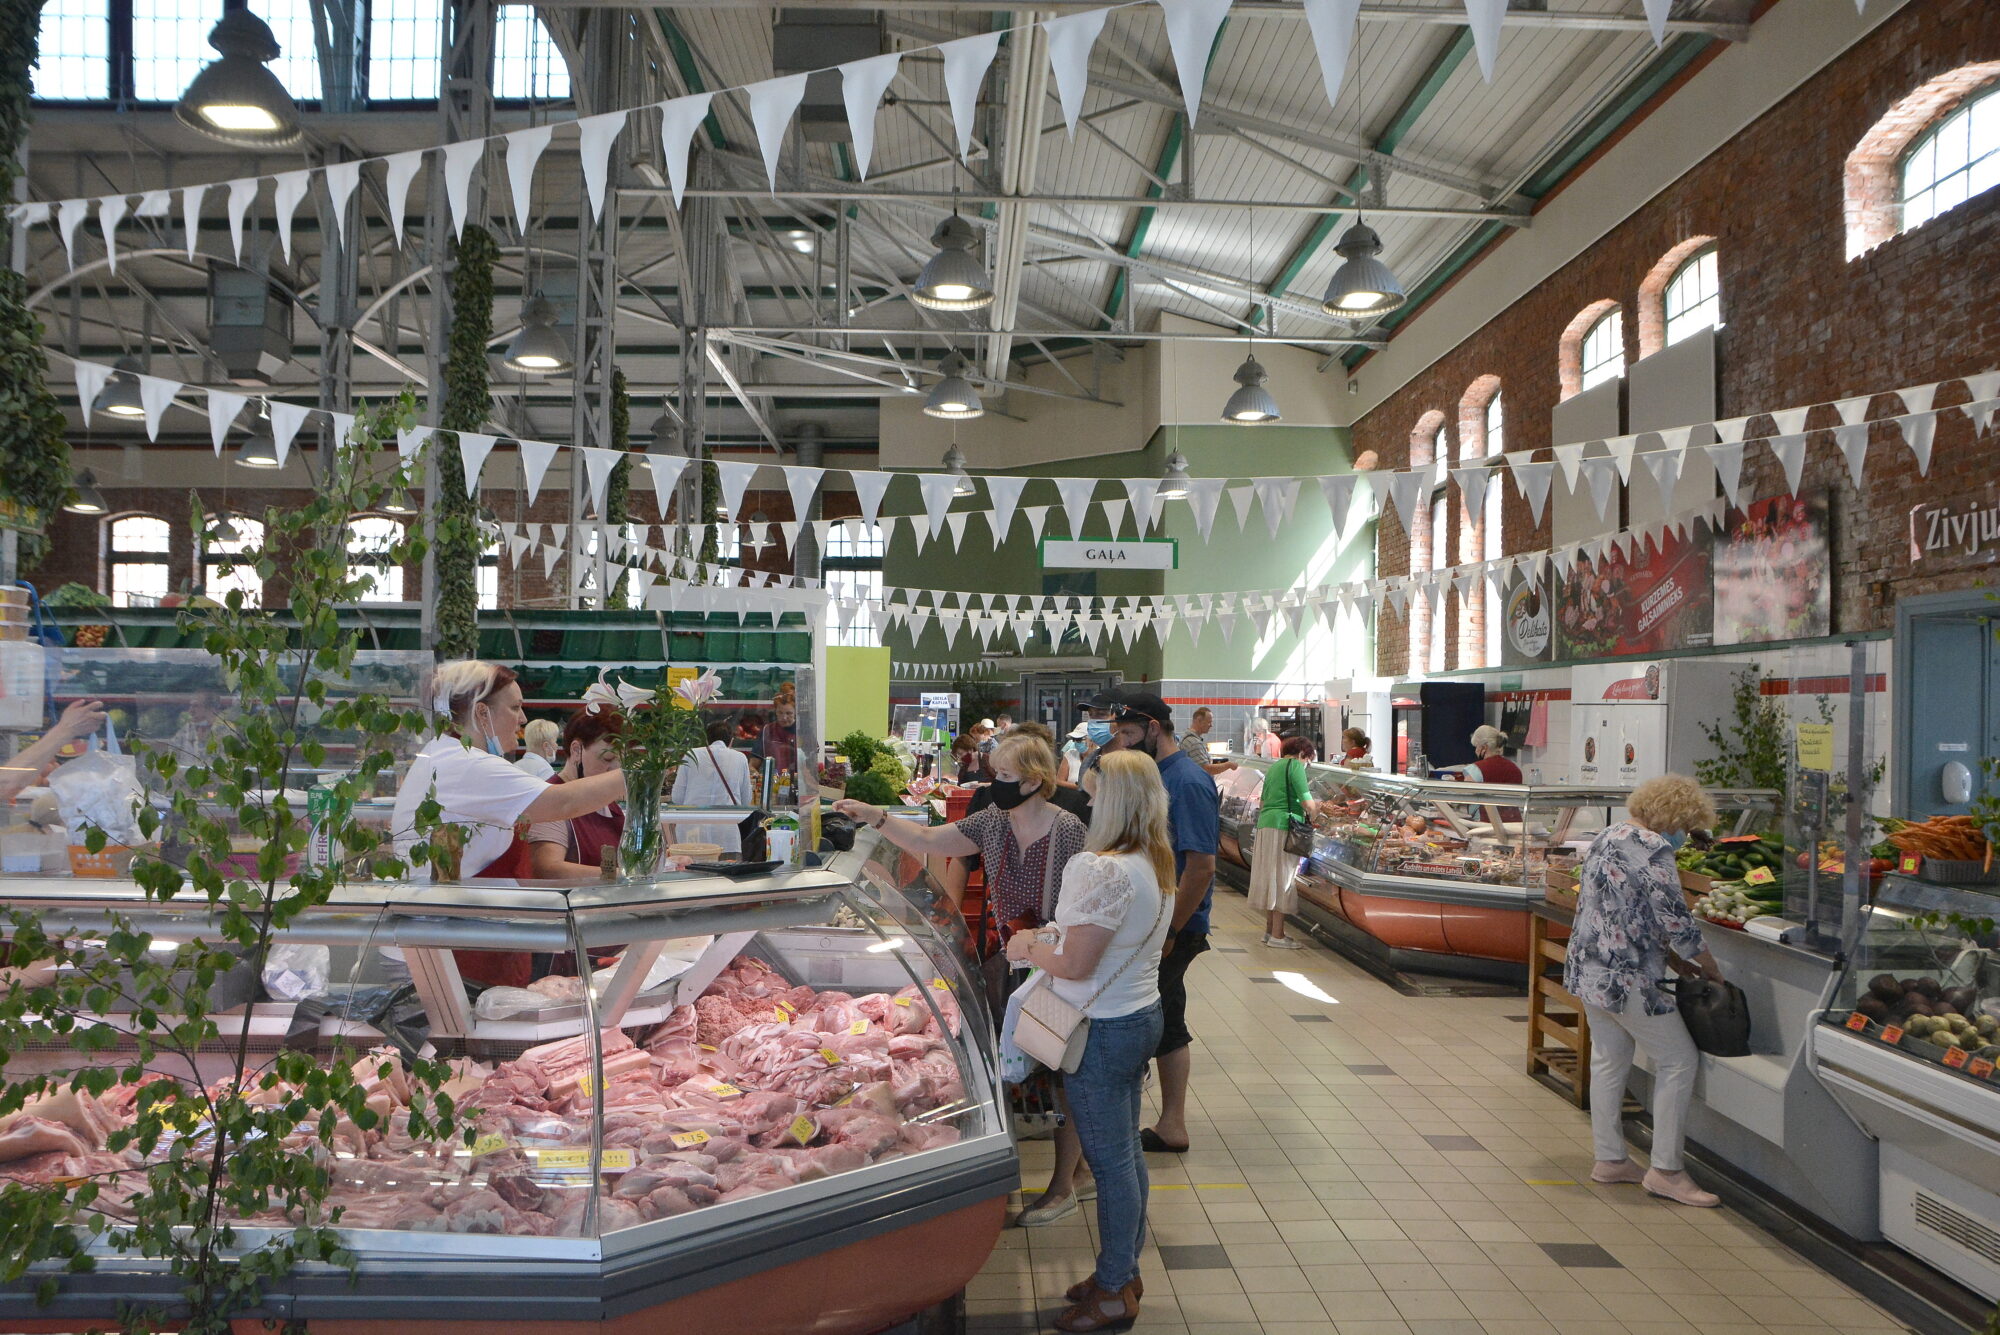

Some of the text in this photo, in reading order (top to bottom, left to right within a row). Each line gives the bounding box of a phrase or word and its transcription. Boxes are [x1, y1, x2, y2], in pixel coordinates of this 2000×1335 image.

[1925, 501, 1998, 556] Zivju
[1086, 549, 1126, 564] GAĻA
[1641, 577, 1675, 614] KURZEMES
